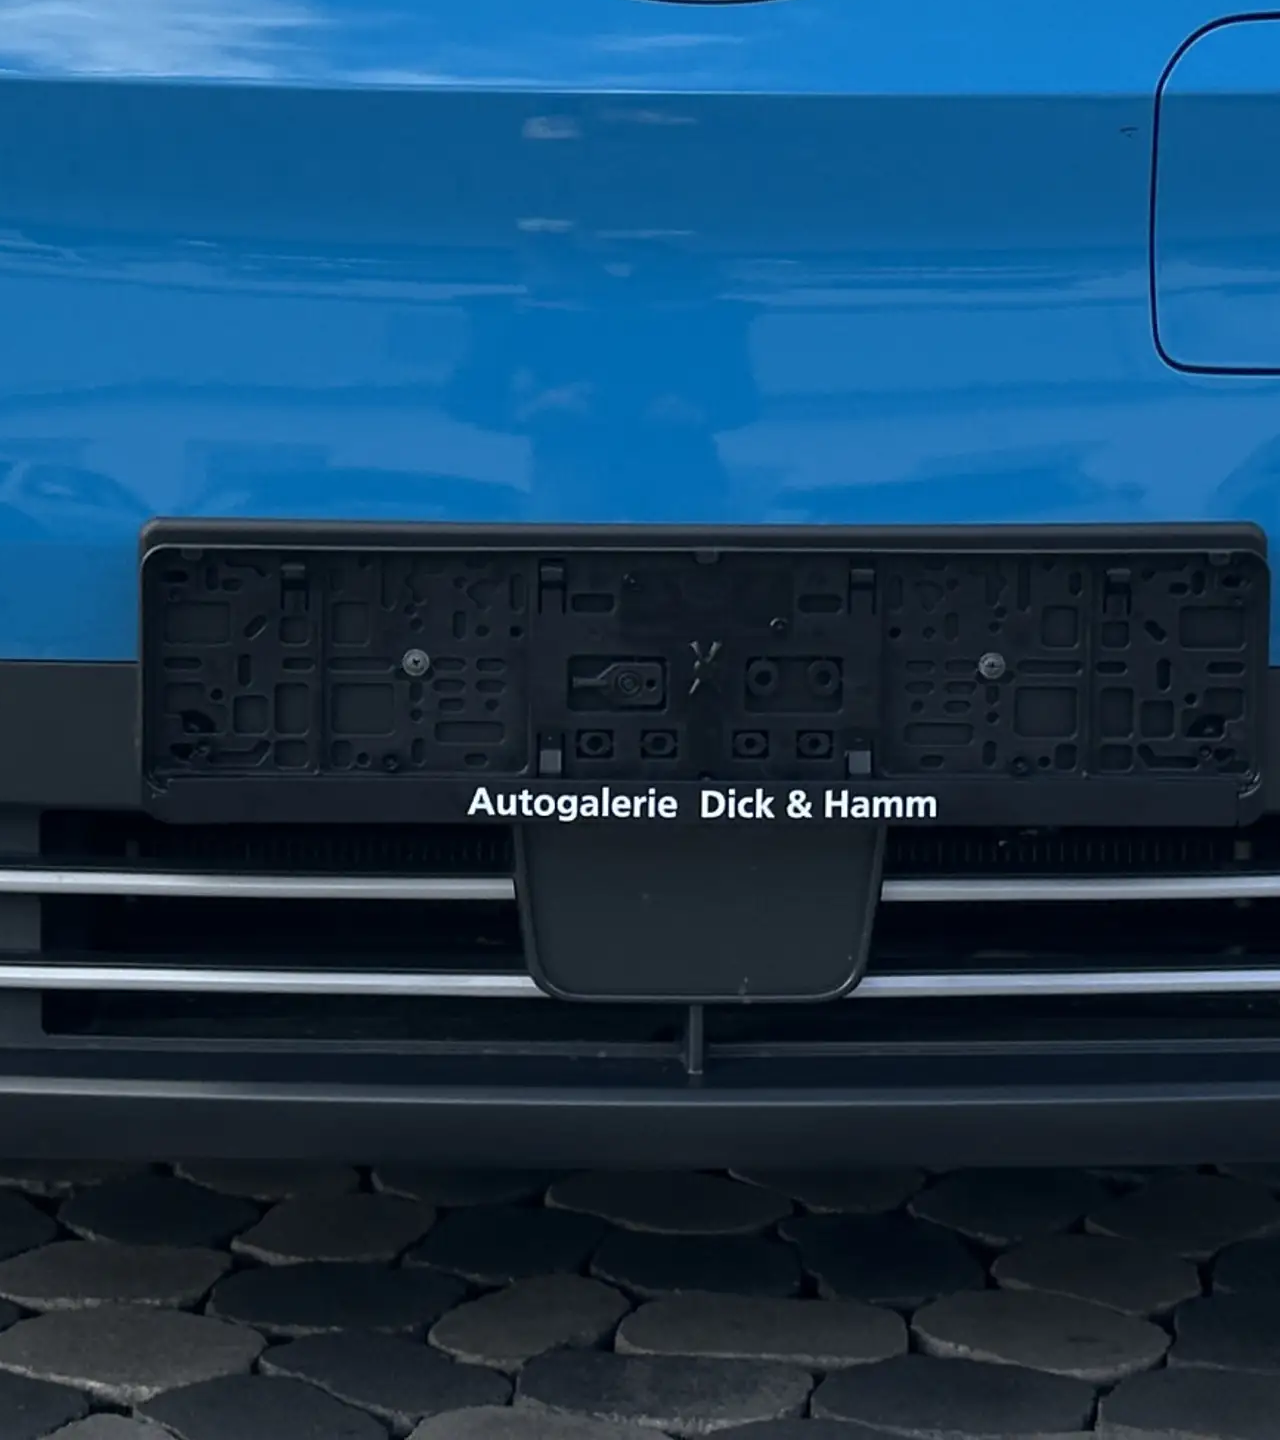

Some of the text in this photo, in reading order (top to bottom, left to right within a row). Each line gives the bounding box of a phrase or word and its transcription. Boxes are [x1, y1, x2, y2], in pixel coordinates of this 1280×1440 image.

[467, 787, 938, 821] Autogalerie Dick & Hamm
